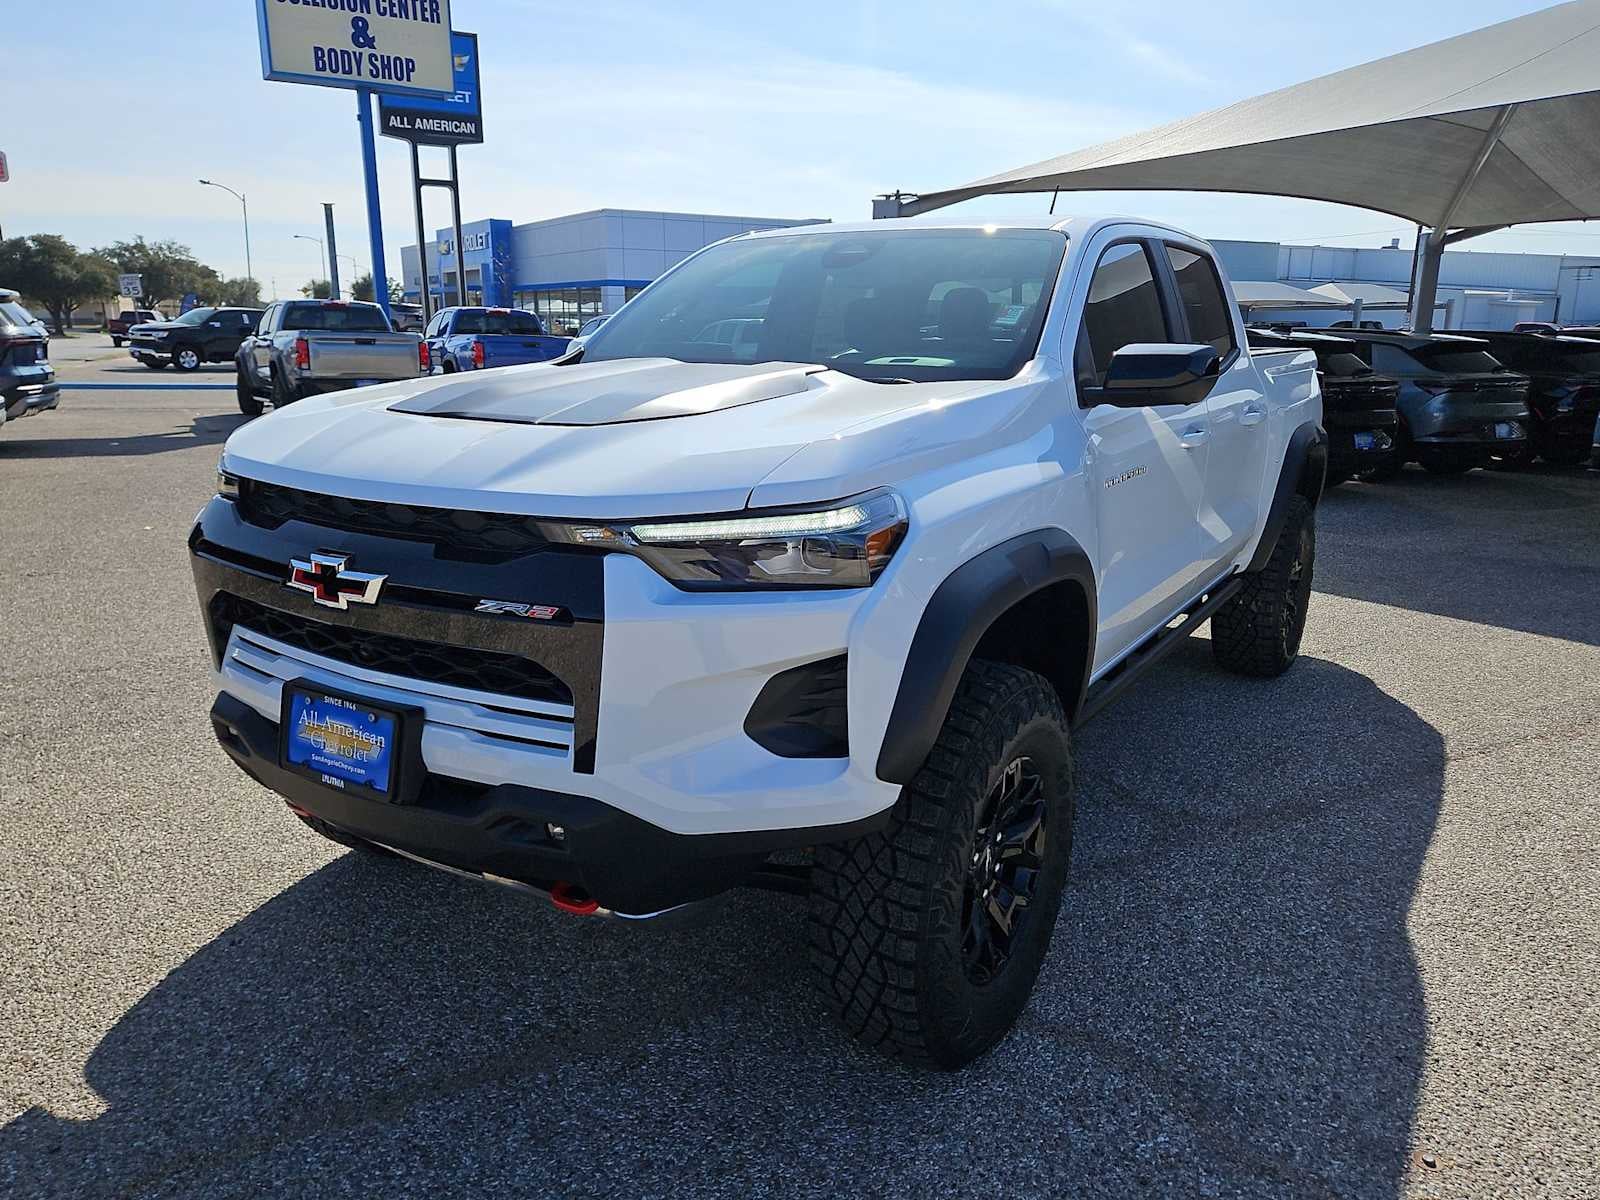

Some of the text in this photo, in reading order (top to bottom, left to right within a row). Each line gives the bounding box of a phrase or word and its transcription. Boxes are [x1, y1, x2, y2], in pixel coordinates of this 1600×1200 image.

[375, 0, 441, 24] CENTER
[351, 16, 376, 50] &
[313, 46, 416, 82] BODY SHOP
[389, 115, 476, 134] ALL AMERICAN
[123, 286, 140, 295] 35
[474, 599, 560, 619] ZR2
[298, 708, 385, 748] All American
[310, 730, 368, 763] Chevrolet
